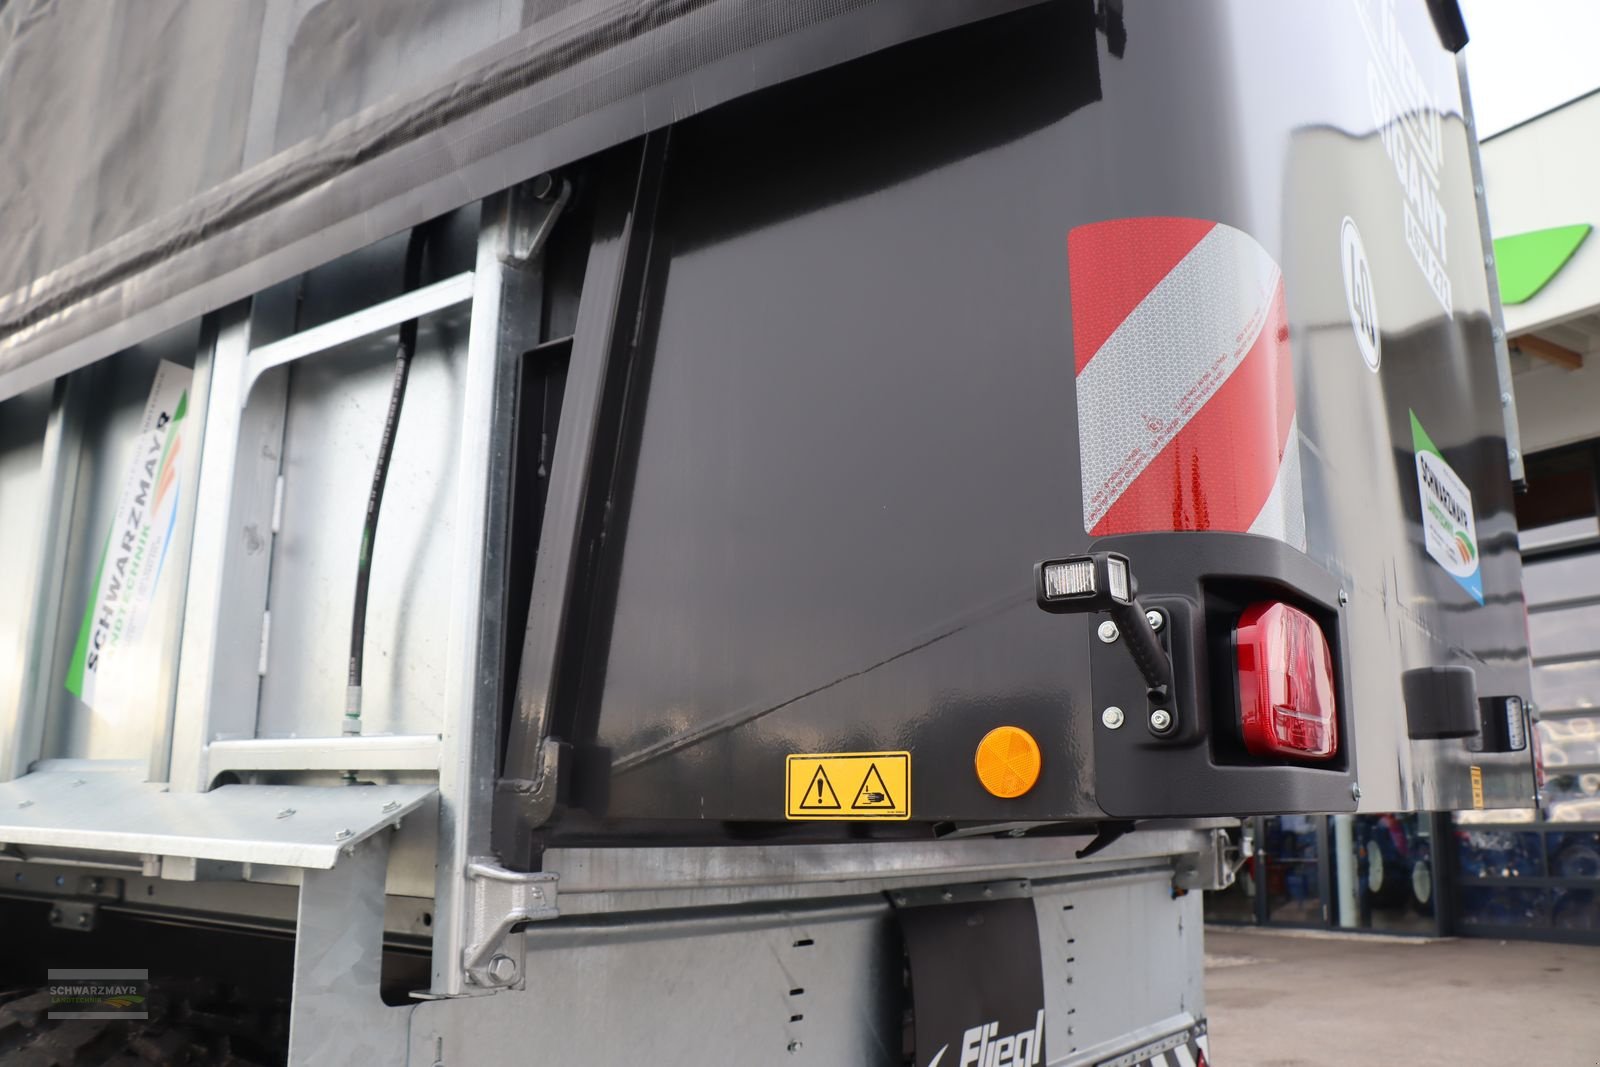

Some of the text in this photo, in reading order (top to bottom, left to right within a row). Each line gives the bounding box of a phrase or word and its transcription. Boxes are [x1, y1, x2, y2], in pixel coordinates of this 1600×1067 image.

[1367, 60, 1447, 265] GIGANT
[1350, 242, 1375, 347] 40
[88, 411, 170, 672] SCHWARZMAYR
[1421, 455, 1468, 528] SCHWARZMAYR
[960, 1009, 1044, 1067] Fliegl
